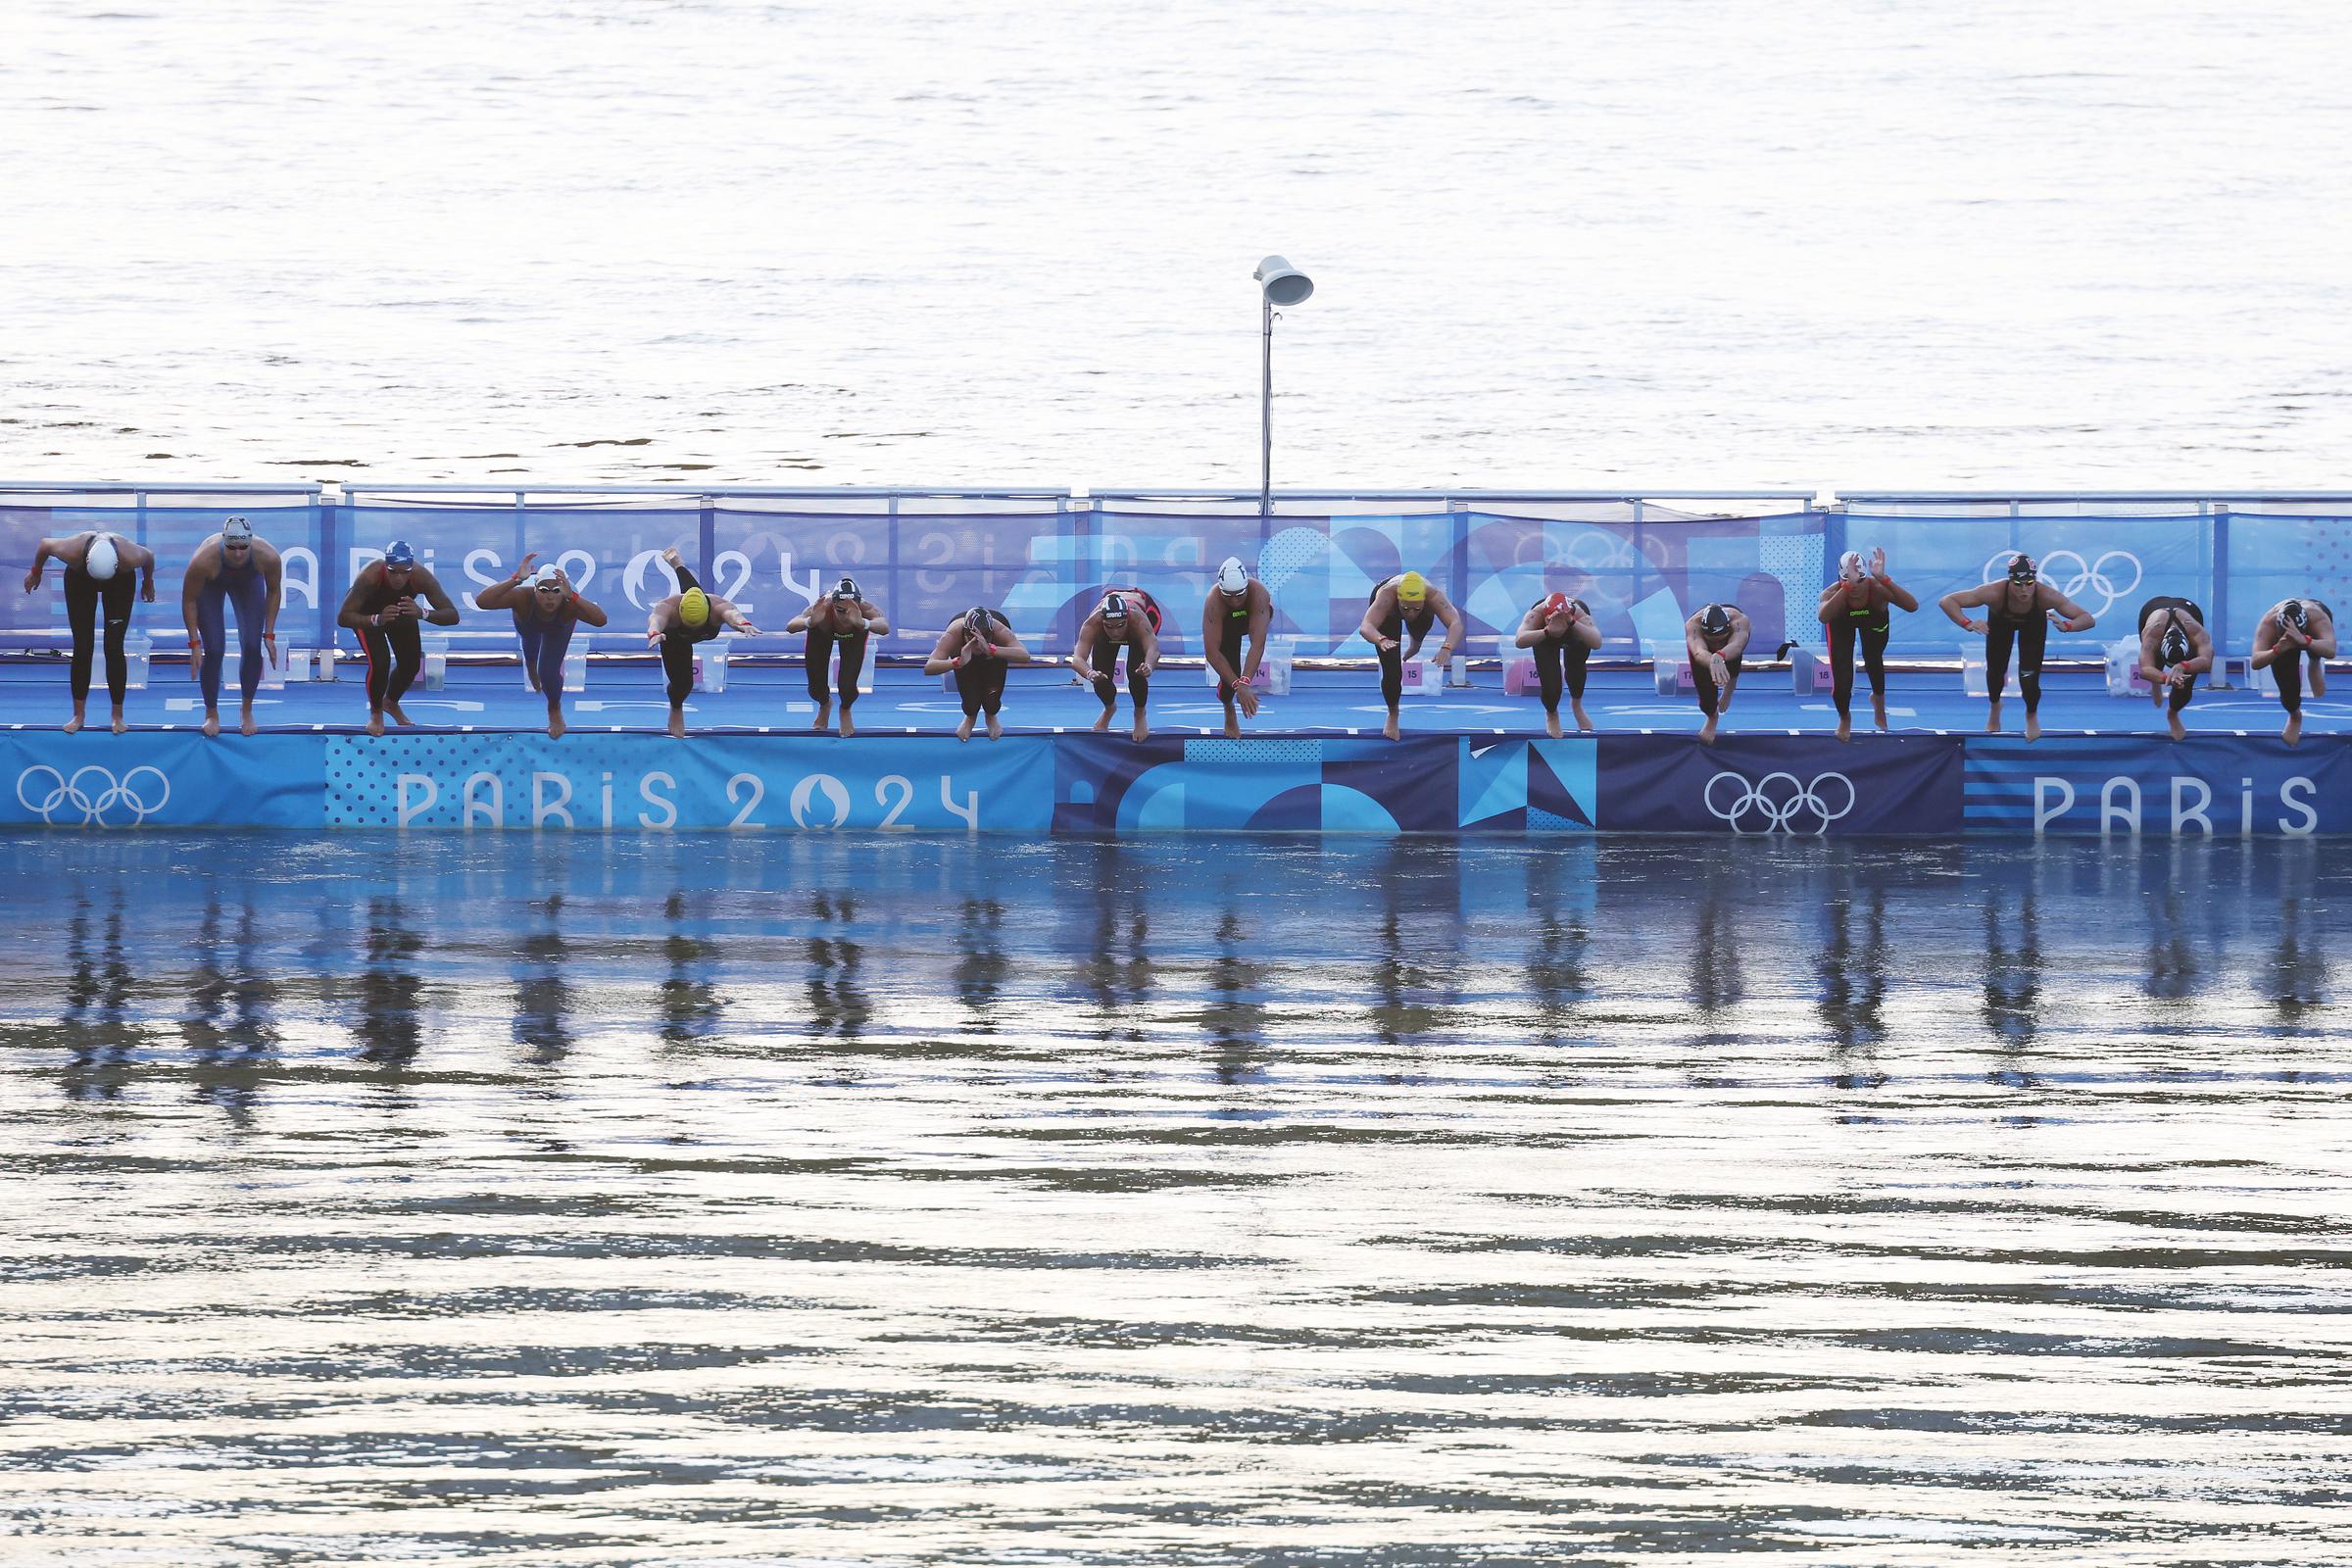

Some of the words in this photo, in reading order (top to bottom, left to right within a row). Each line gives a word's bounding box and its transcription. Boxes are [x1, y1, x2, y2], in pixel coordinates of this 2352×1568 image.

[1407, 670, 1417, 679] 15
[397, 771, 677, 830] PARiS
[726, 772, 978, 832] 2024
[2034, 775, 2318, 834] PARiS
